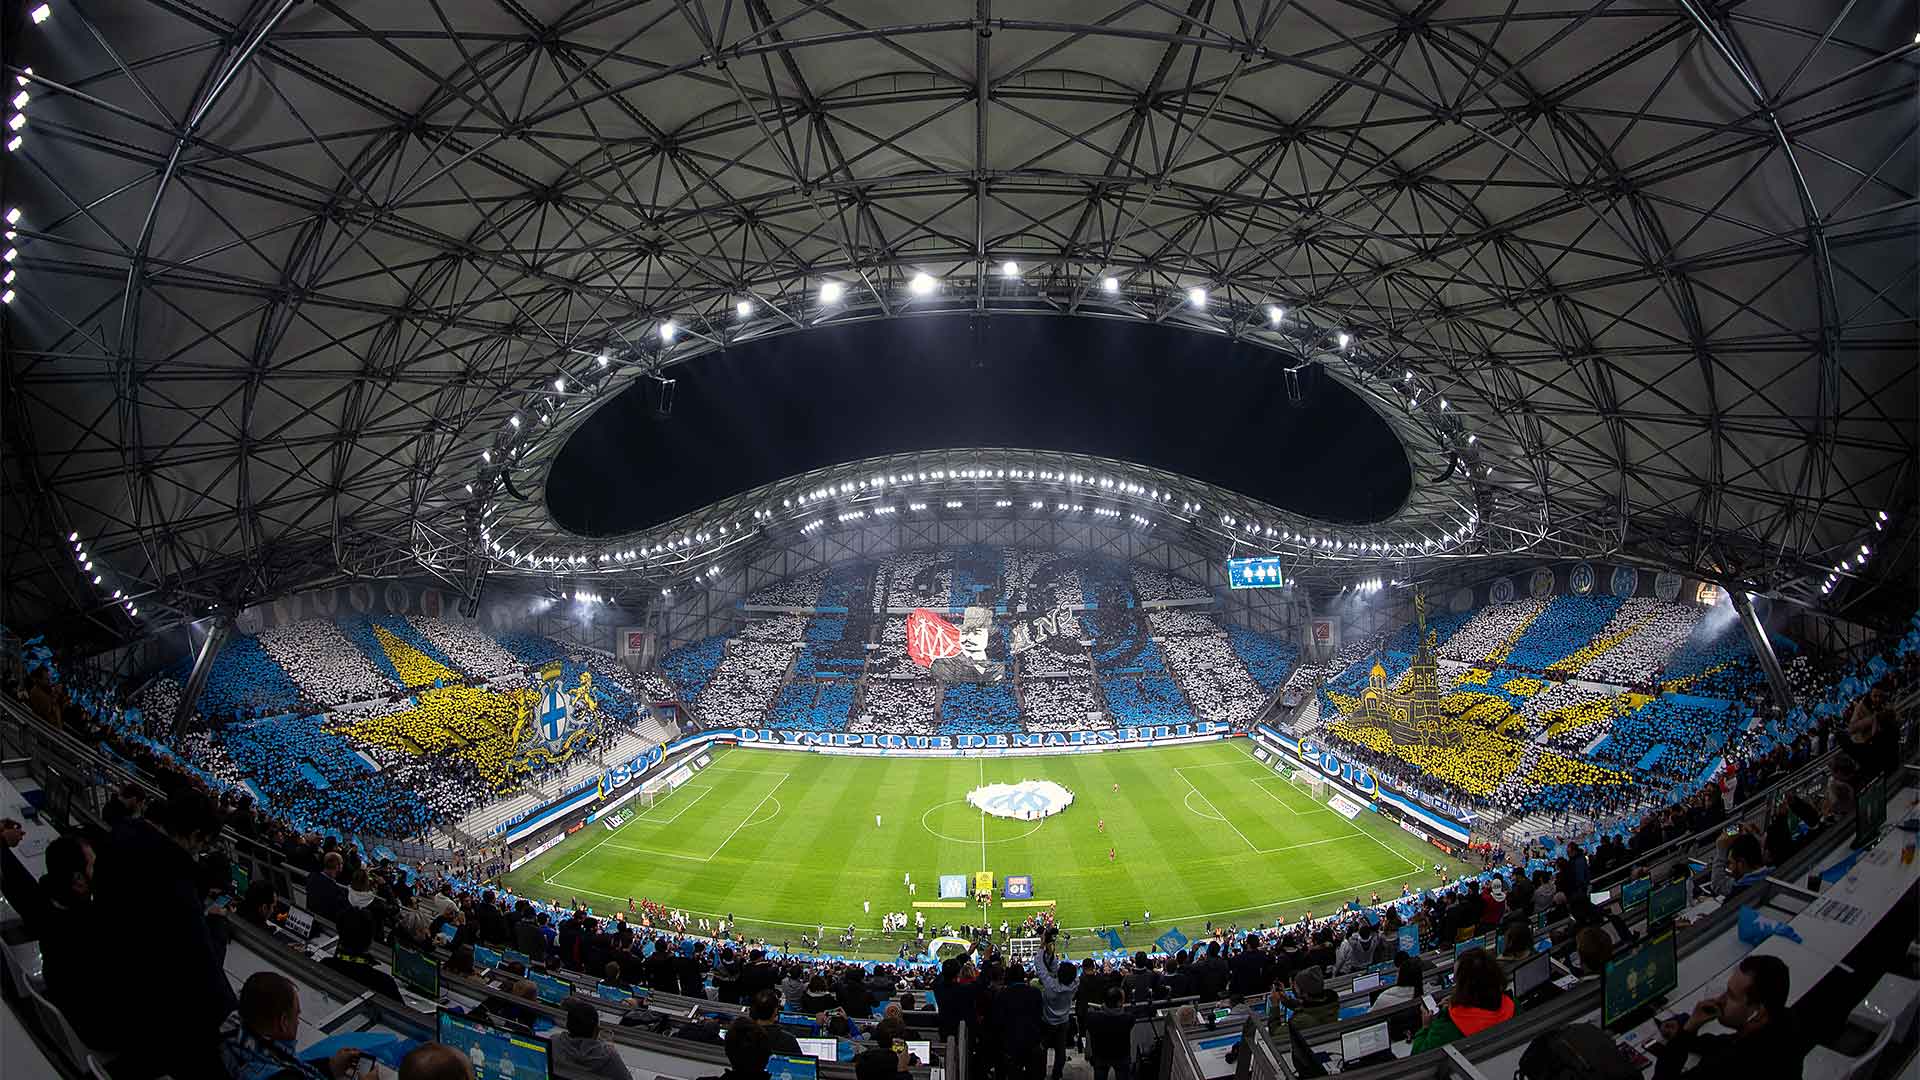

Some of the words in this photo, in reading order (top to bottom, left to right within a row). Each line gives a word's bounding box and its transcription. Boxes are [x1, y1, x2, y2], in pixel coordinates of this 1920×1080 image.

[1011, 602, 1073, 653] ANS
[733, 728, 953, 749] OLYMPIQUE
[956, 734, 1008, 748] DE
[1012, 721, 1217, 748] MARSEILLE
